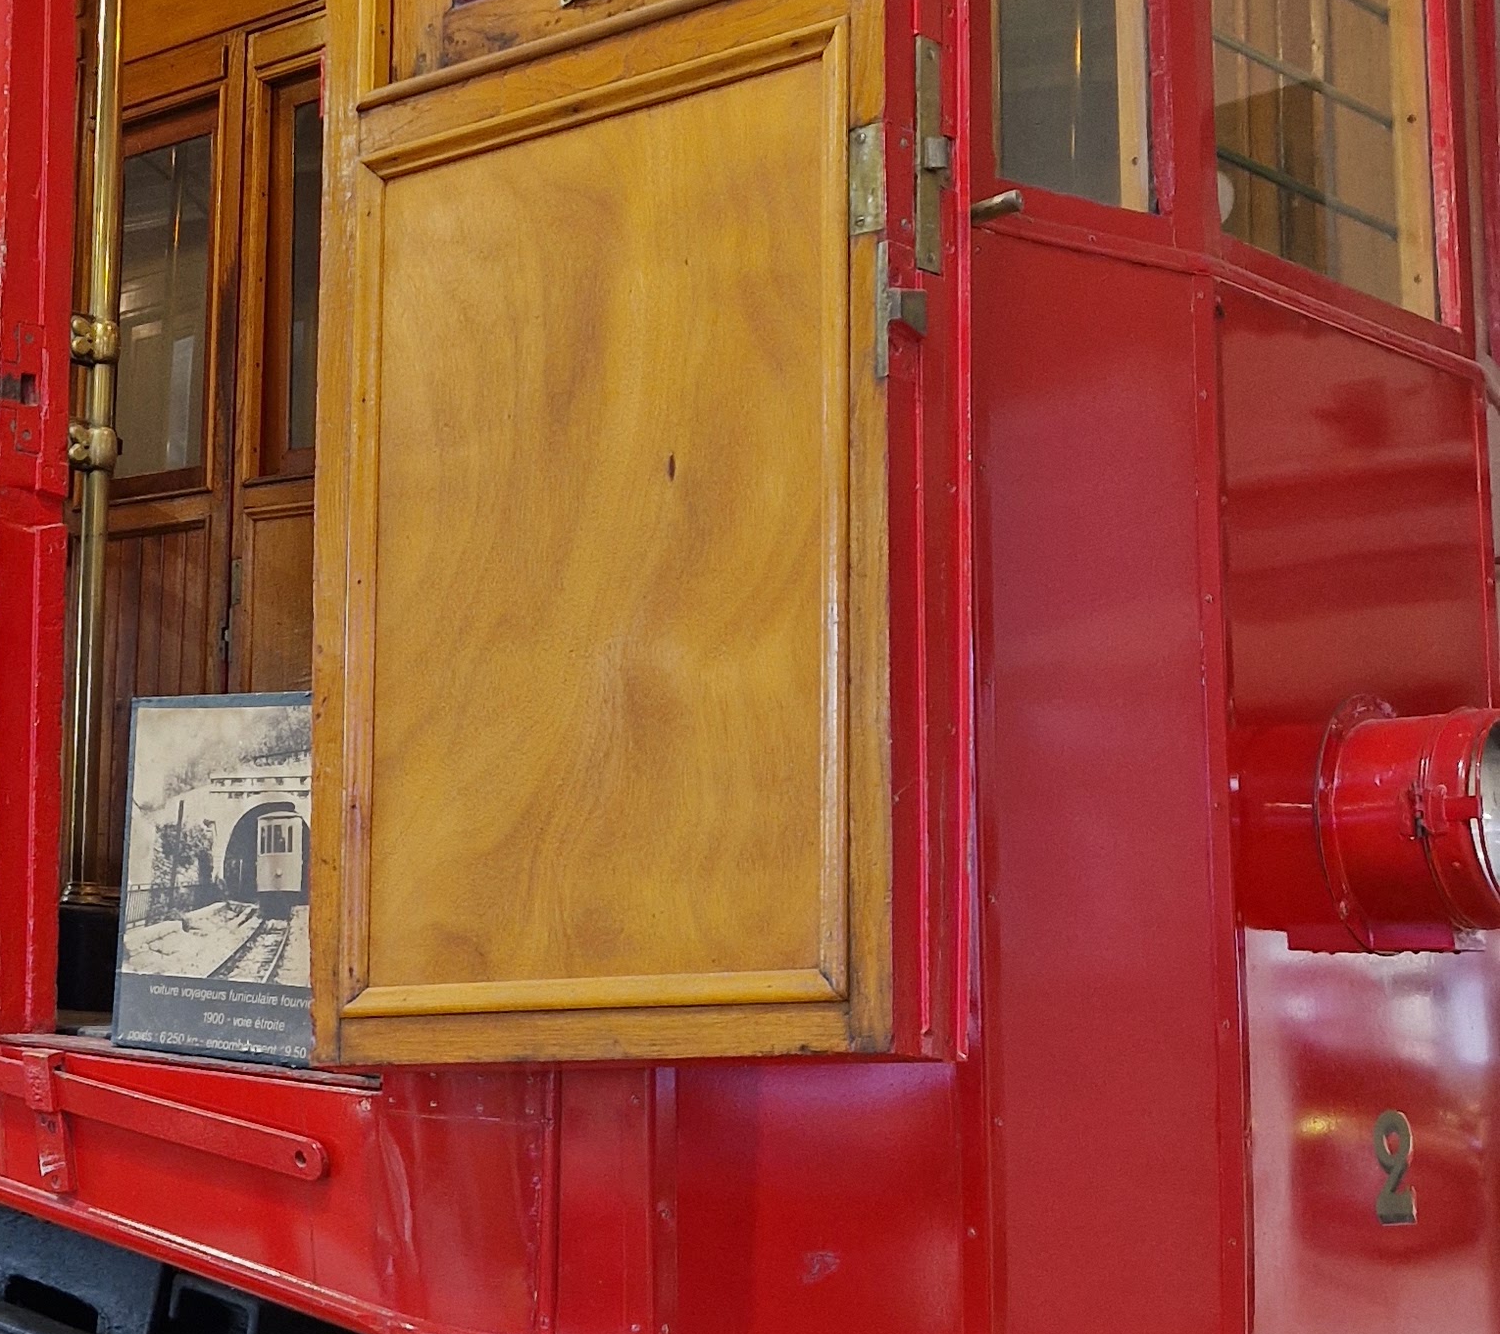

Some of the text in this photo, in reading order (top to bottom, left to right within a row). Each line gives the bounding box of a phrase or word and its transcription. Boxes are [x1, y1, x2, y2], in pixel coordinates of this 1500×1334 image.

[150, 984, 178, 996] voiture
[181, 987, 227, 1002] voyageurs
[229, 990, 278, 1005] funiculaire
[203, 1012, 225, 1025] 1900
[233, 1017, 252, 1028] voie
[254, 1017, 286, 1032] étroite
[1373, 1109, 1417, 1226] 2
